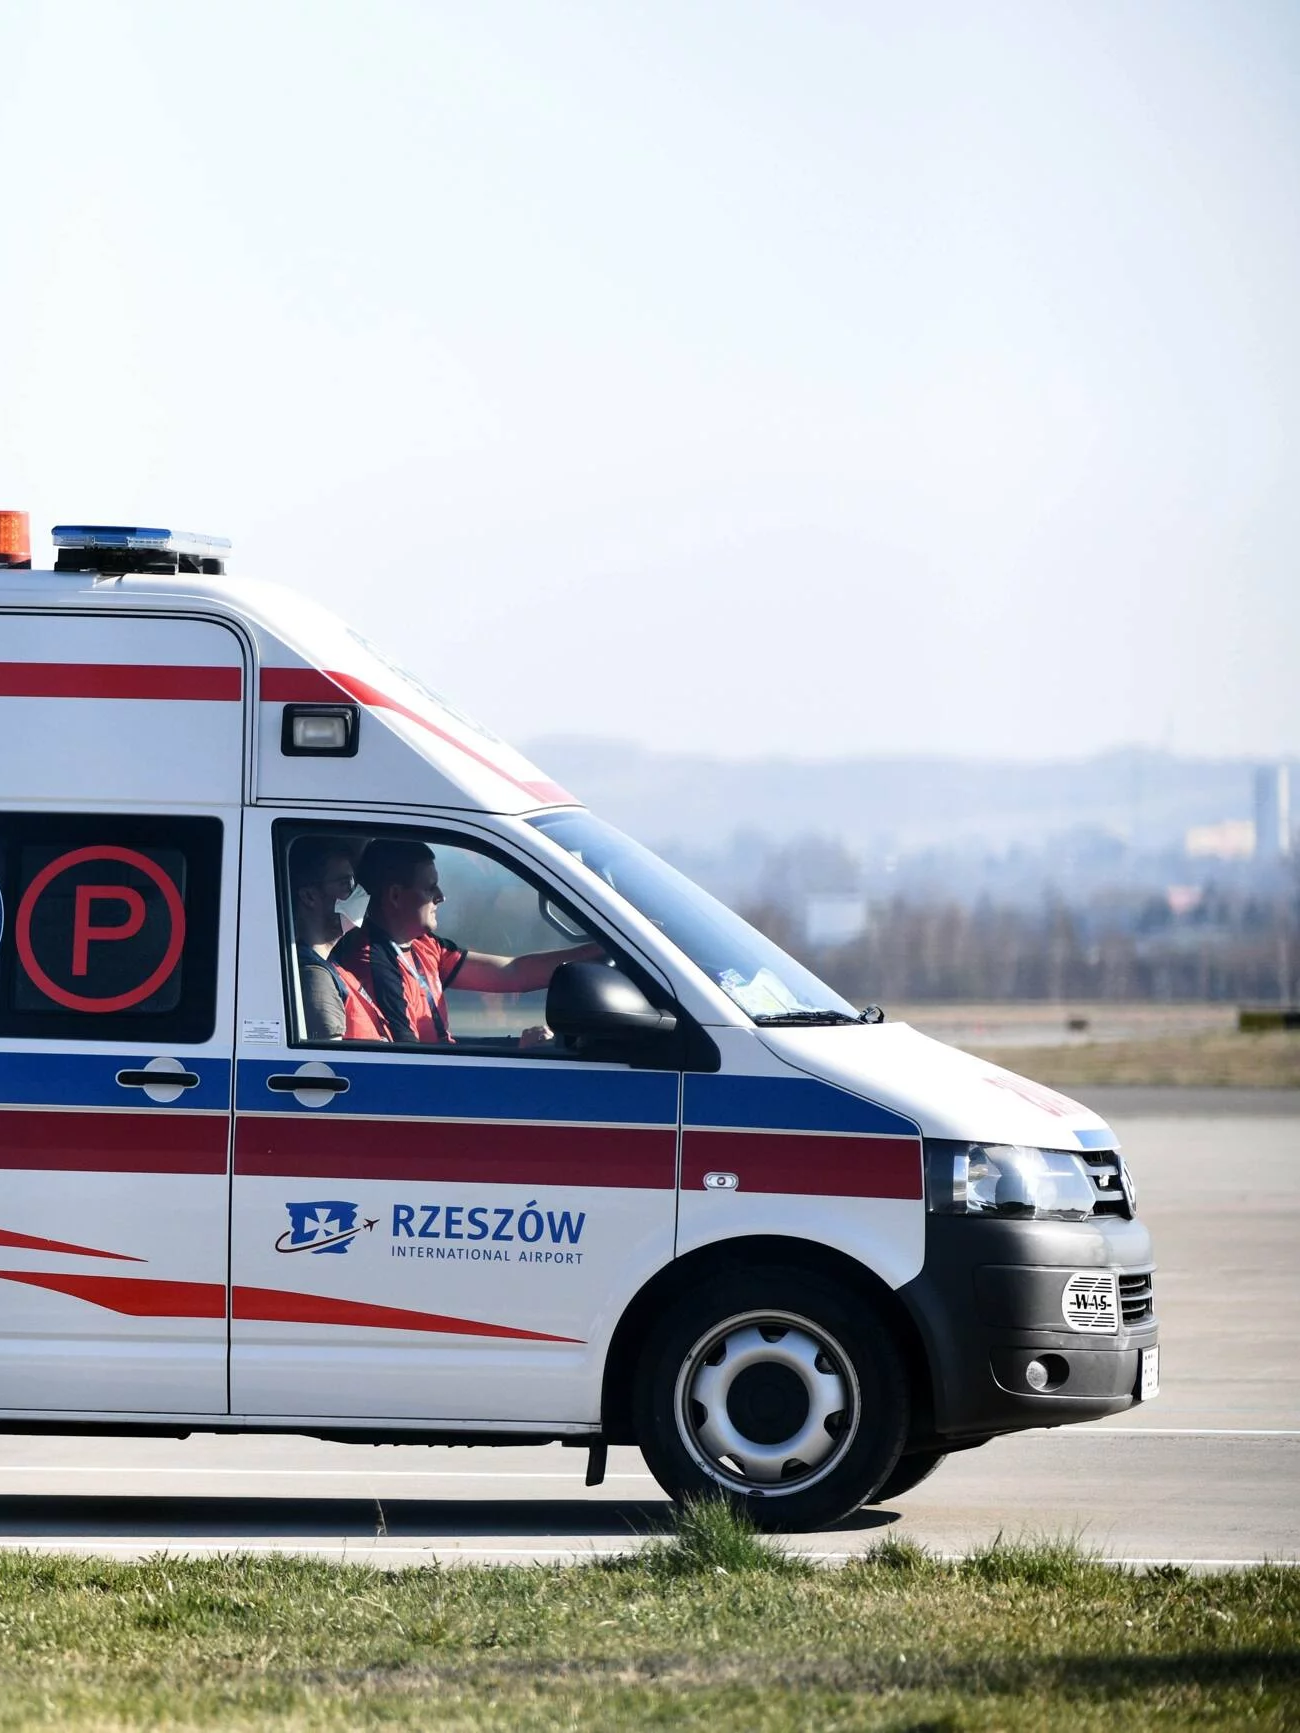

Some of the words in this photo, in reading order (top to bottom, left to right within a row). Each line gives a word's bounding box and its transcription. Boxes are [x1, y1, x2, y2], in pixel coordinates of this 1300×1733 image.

[71, 884, 147, 977] P
[392, 1199, 587, 1244] RZESZÓW
[391, 1245, 511, 1262] INTERNATIONAL
[518, 1250, 585, 1265] AIRPORT
